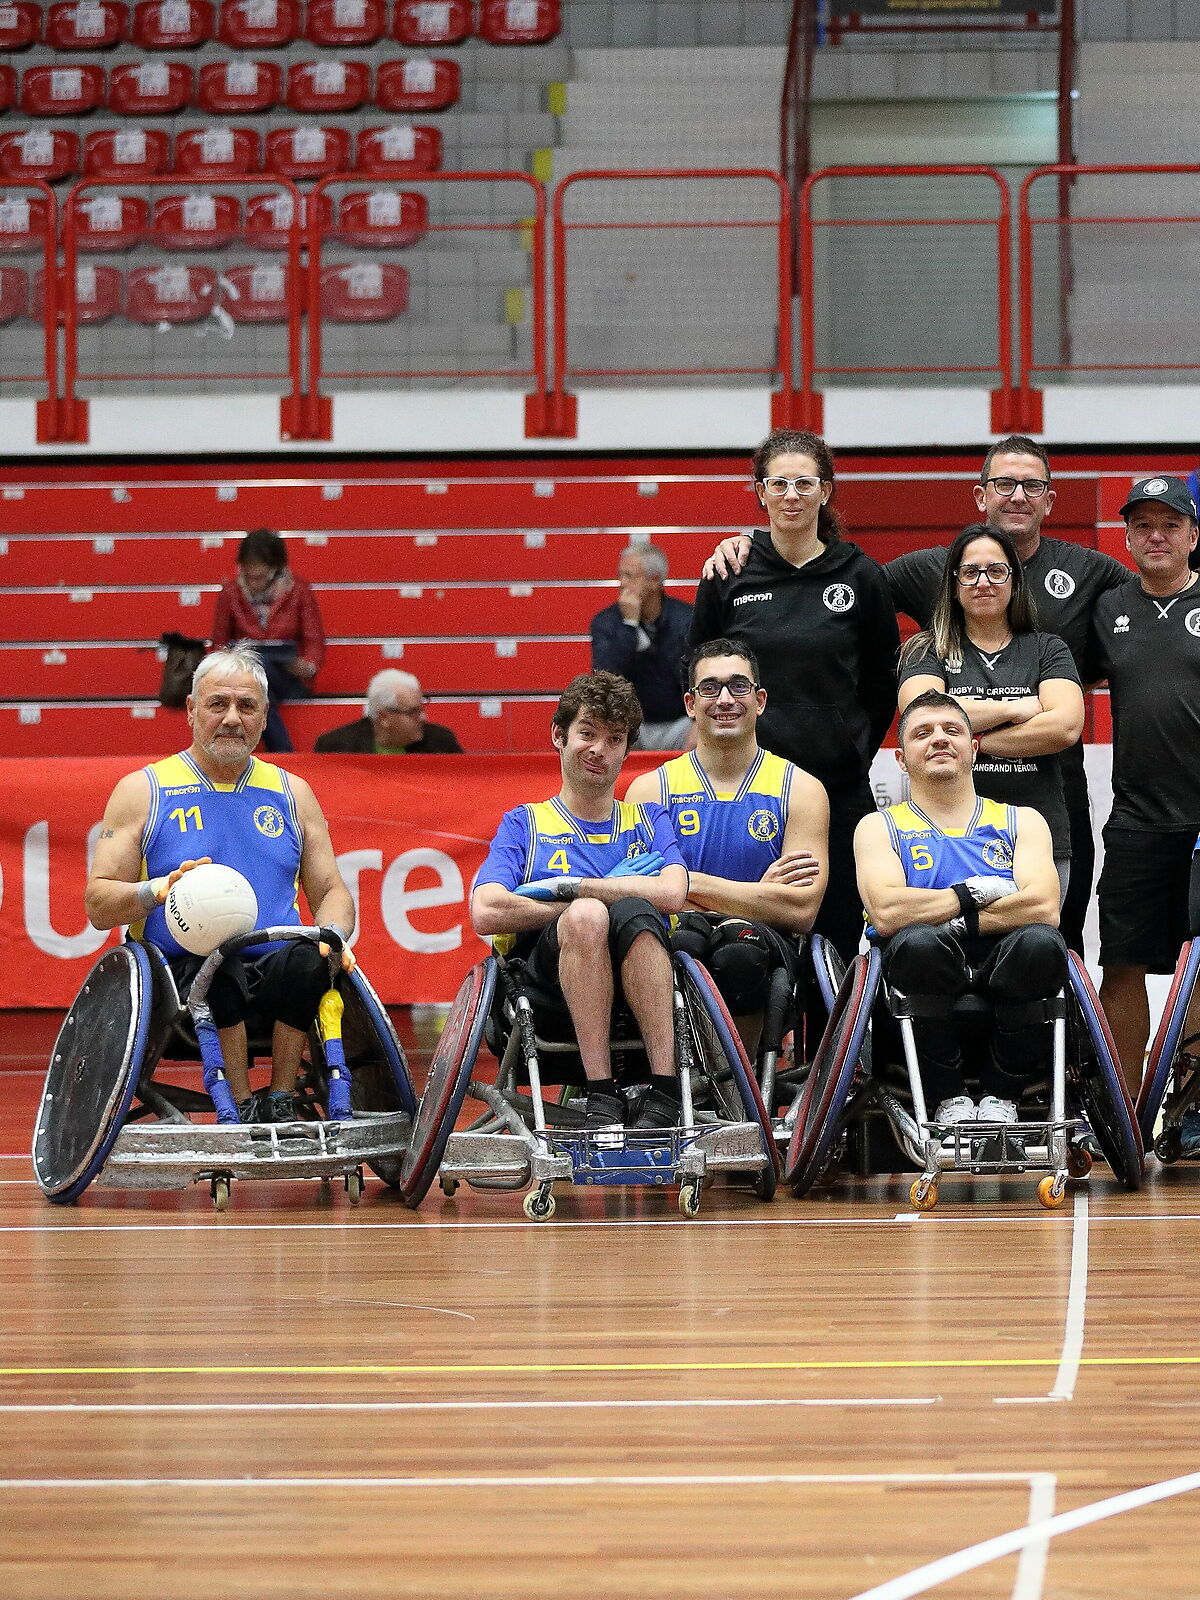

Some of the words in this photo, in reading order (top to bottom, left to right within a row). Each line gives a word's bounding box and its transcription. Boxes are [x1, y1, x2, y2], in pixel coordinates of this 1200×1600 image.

[733, 592, 773, 606] macron
[976, 686, 985, 694] IN
[165, 786, 201, 796] macron
[671, 795, 704, 804] macron
[169, 805, 204, 833] 11
[678, 809, 701, 836] 9
[547, 849, 572, 874] 4
[910, 845, 934, 871] 5
